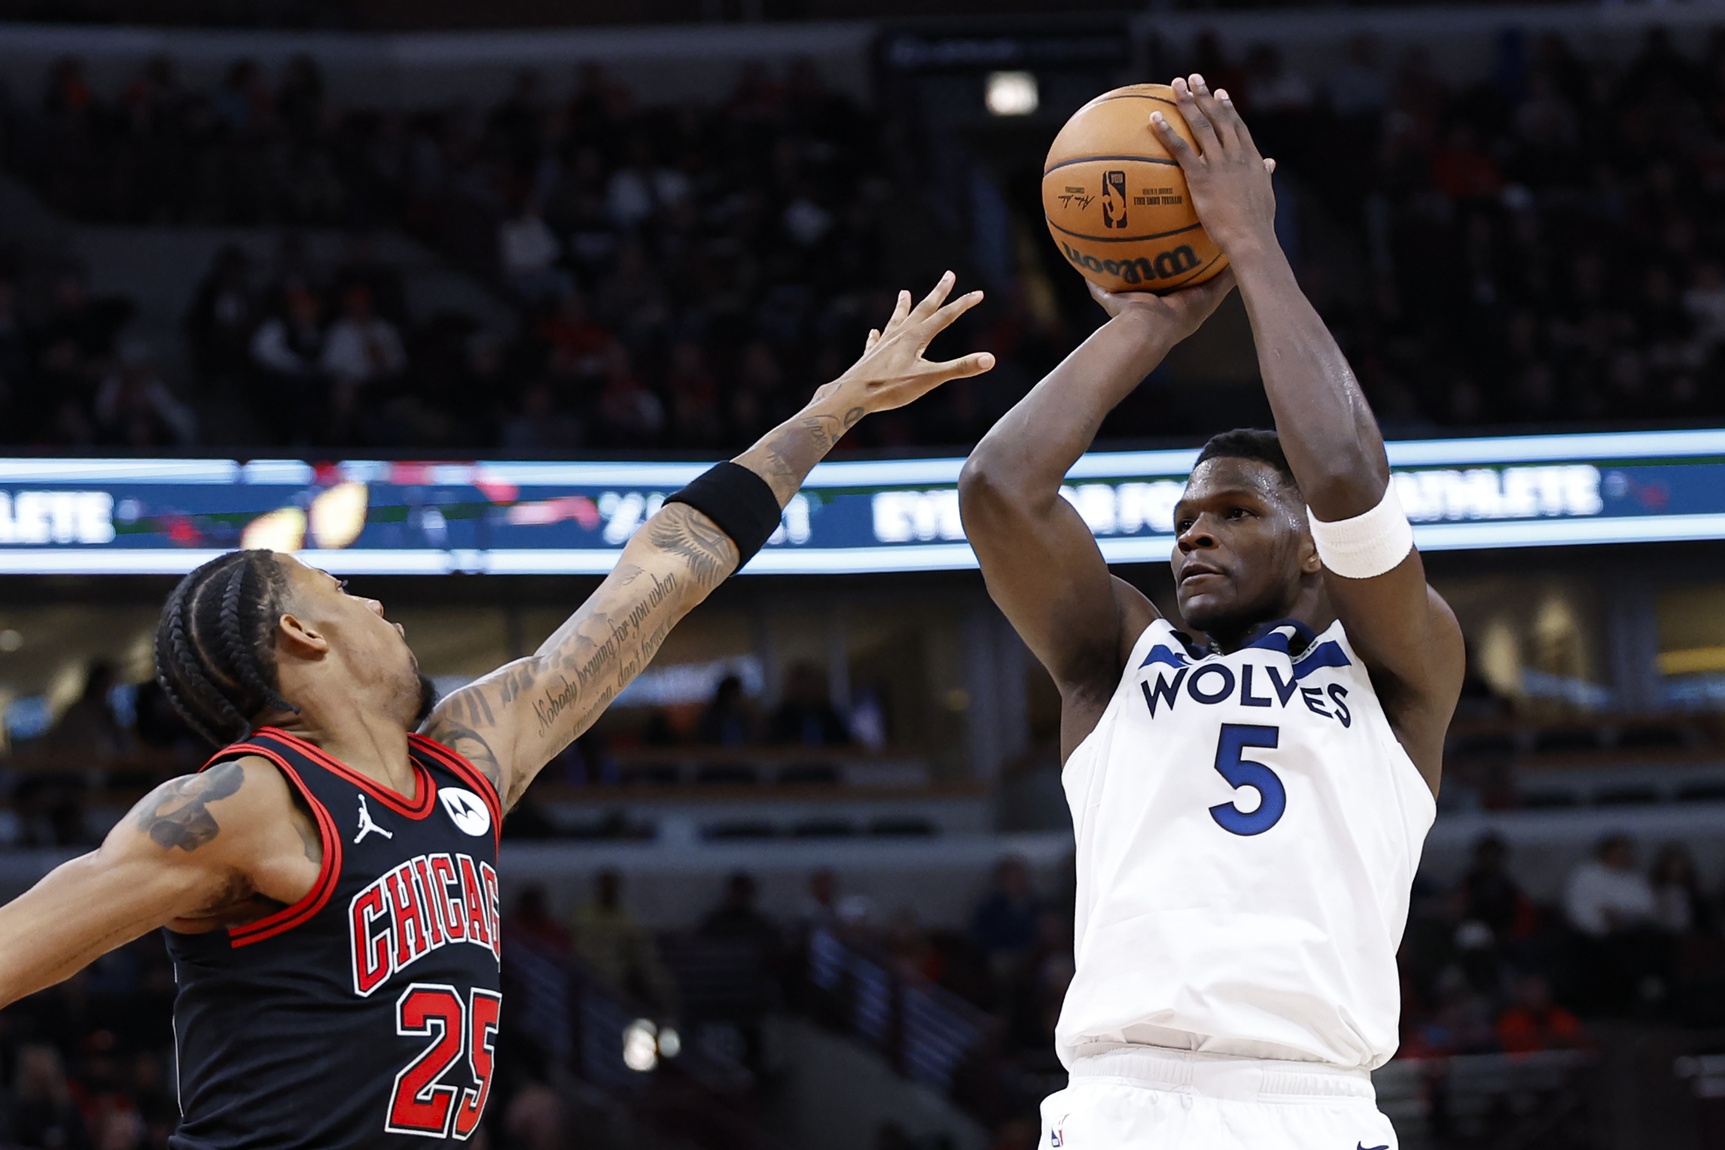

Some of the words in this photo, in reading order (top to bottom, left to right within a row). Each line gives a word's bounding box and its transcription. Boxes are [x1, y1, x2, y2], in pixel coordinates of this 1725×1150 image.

[1061, 241, 1202, 284] Wilson
[532, 674, 578, 738] Nobody
[628, 599, 651, 640] you
[1141, 663, 1351, 728] WOLVES
[1208, 723, 1287, 836] 5
[384, 982, 502, 1142] 25
